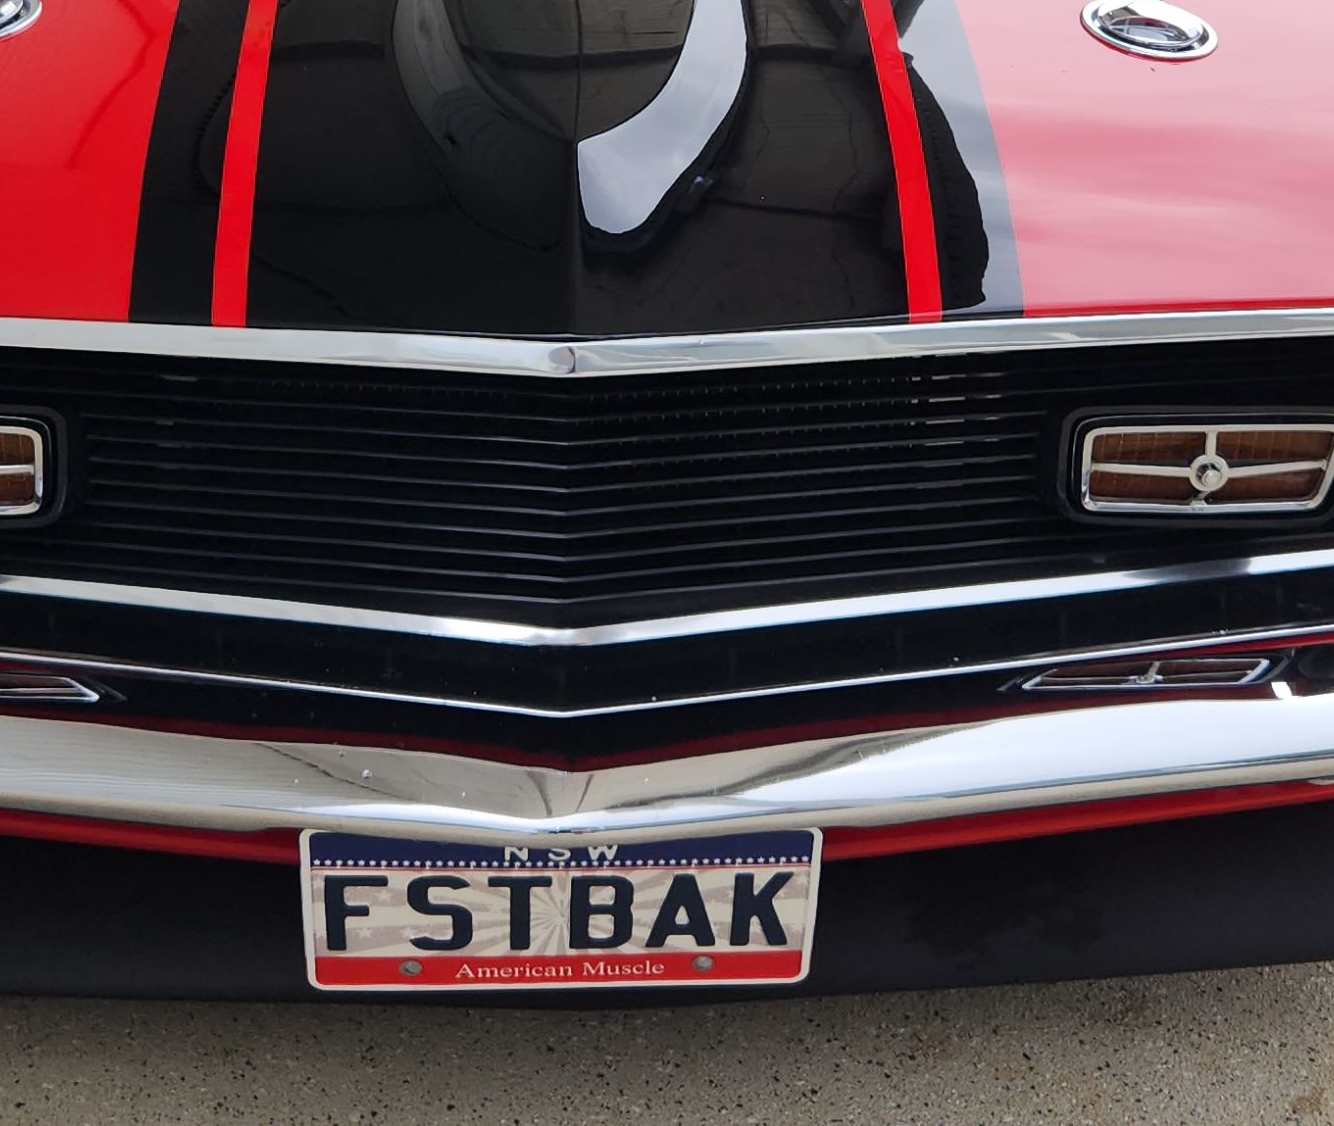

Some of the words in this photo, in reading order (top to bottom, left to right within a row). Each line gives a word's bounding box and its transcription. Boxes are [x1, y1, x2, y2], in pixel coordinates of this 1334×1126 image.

[324, 872, 795, 950] FSTBAK
[455, 963, 573, 978] American
[582, 960, 665, 976] Muscle
